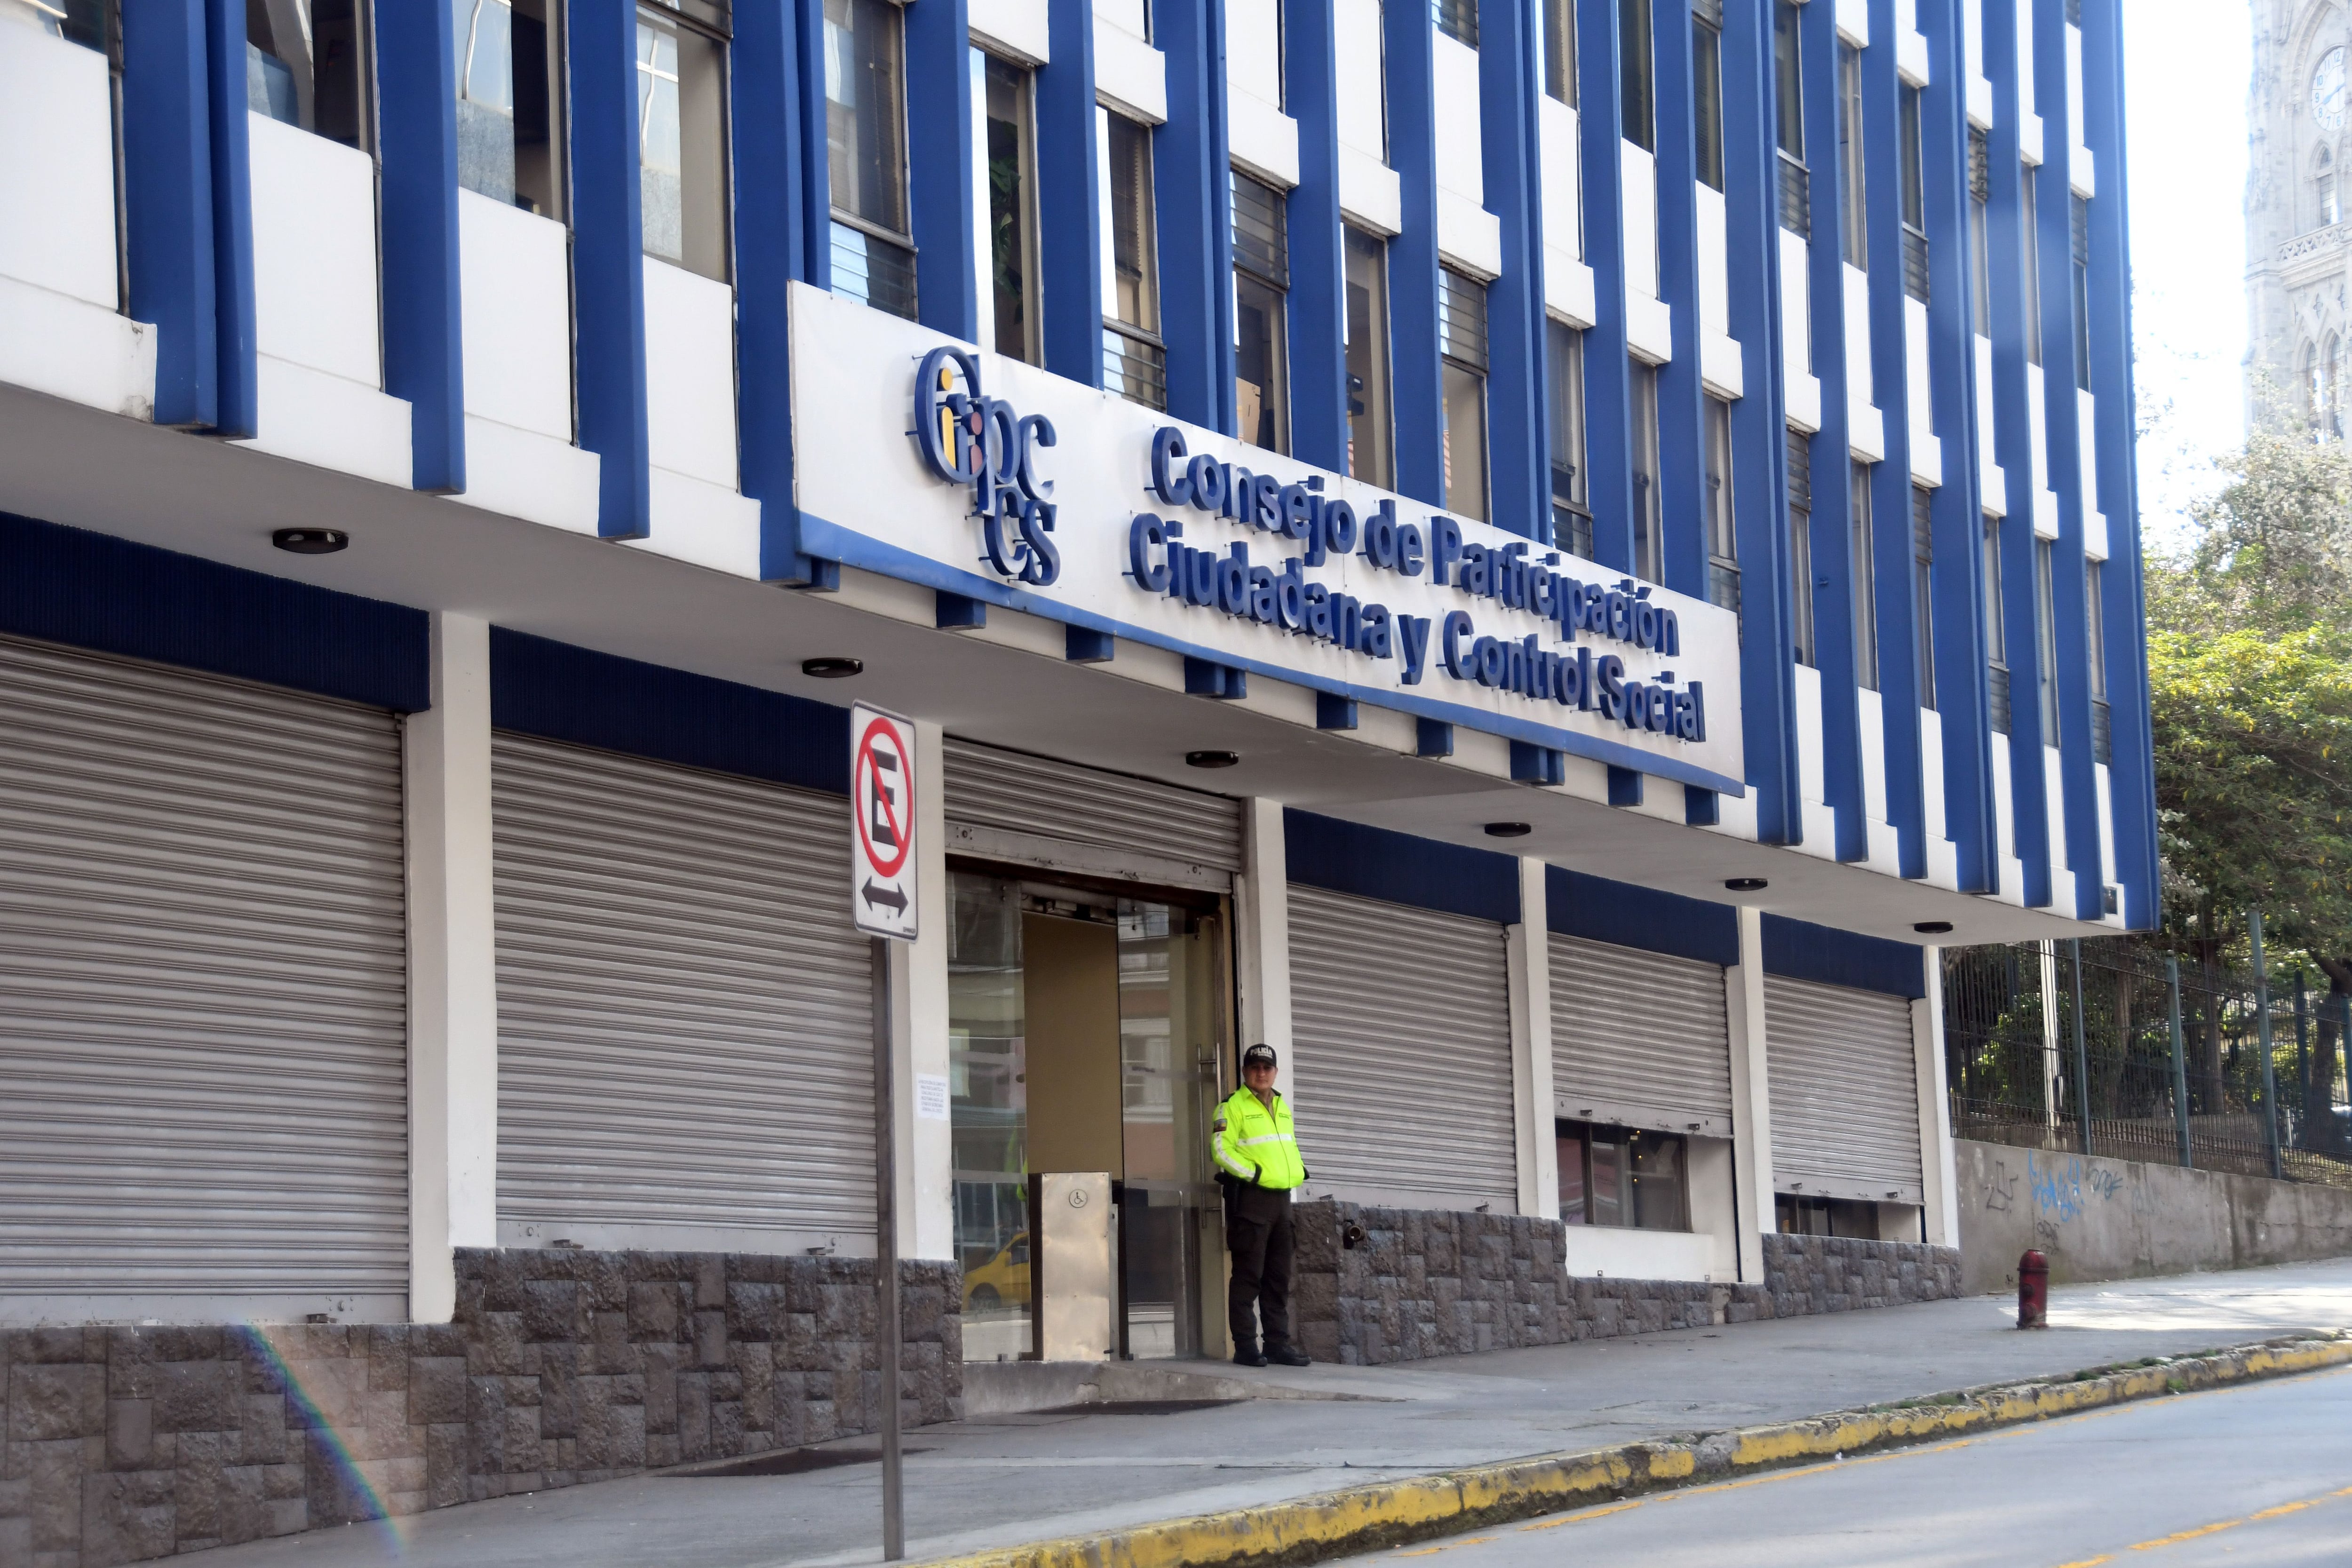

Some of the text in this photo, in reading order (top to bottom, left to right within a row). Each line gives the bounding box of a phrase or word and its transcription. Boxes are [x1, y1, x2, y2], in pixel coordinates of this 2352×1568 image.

[2334, 51, 2341, 62] 12
[2325, 60, 2330, 72] 11
[2317, 75, 2323, 87] 10
[2315, 92, 2319, 103] 9
[2319, 108, 2322, 118] 8
[2327, 116, 2331, 129] 7
[2336, 116, 2341, 126] 6
[1151, 426, 1679, 657] Consejo de Participación
[1130, 513, 1706, 742] Ciudadana y Control Social
